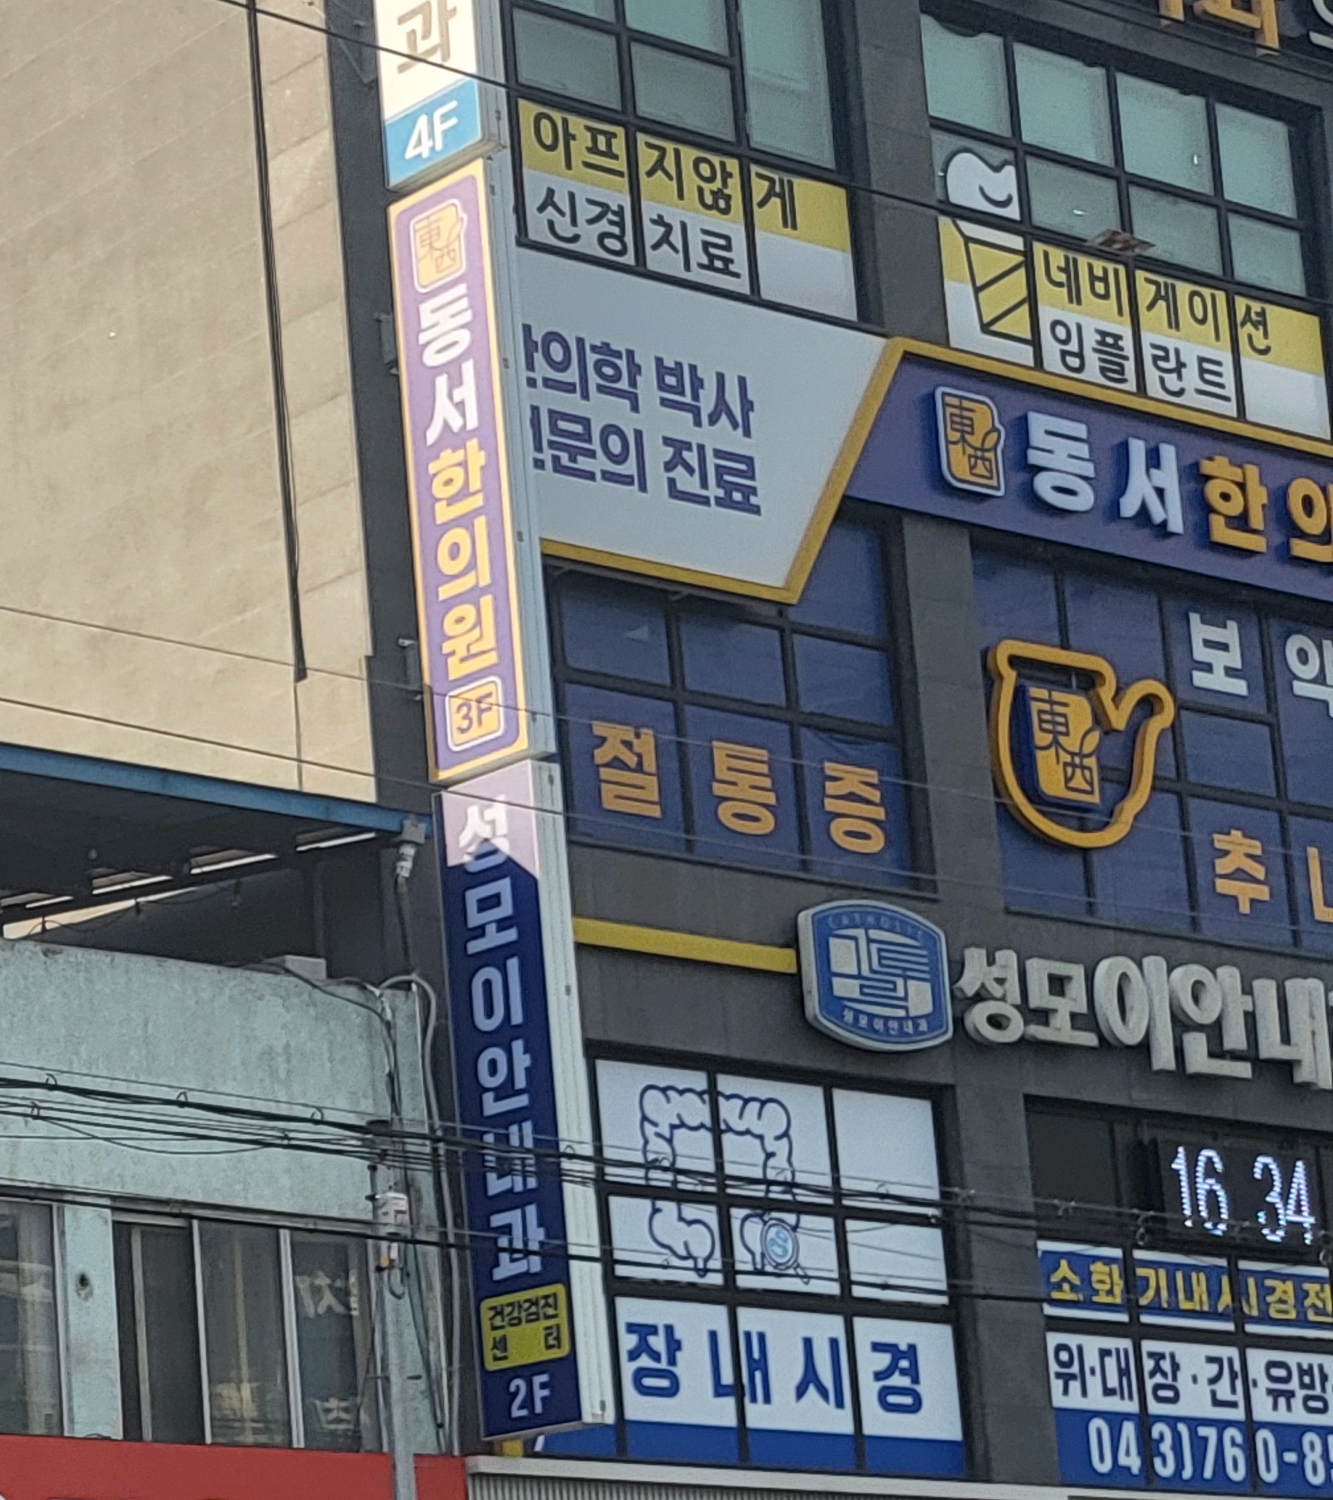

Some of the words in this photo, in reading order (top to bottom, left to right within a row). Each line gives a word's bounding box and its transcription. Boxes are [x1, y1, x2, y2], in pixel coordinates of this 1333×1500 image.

[404, 100, 459, 160] 4F
[536, 186, 741, 279] 신경치료
[1042, 249, 1272, 356] 네비게이션
[654, 355, 755, 438] 박사
[1049, 317, 1232, 403] 임플란트
[418, 282, 501, 680] 동서한의원
[662, 434, 762, 516] 진료
[453, 690, 496, 736] 3F
[952, 945, 1333, 1090] 성모이안내
[507, 1372, 552, 1420] 2F
[1087, 1416, 1333, 1487] 043)760-8
